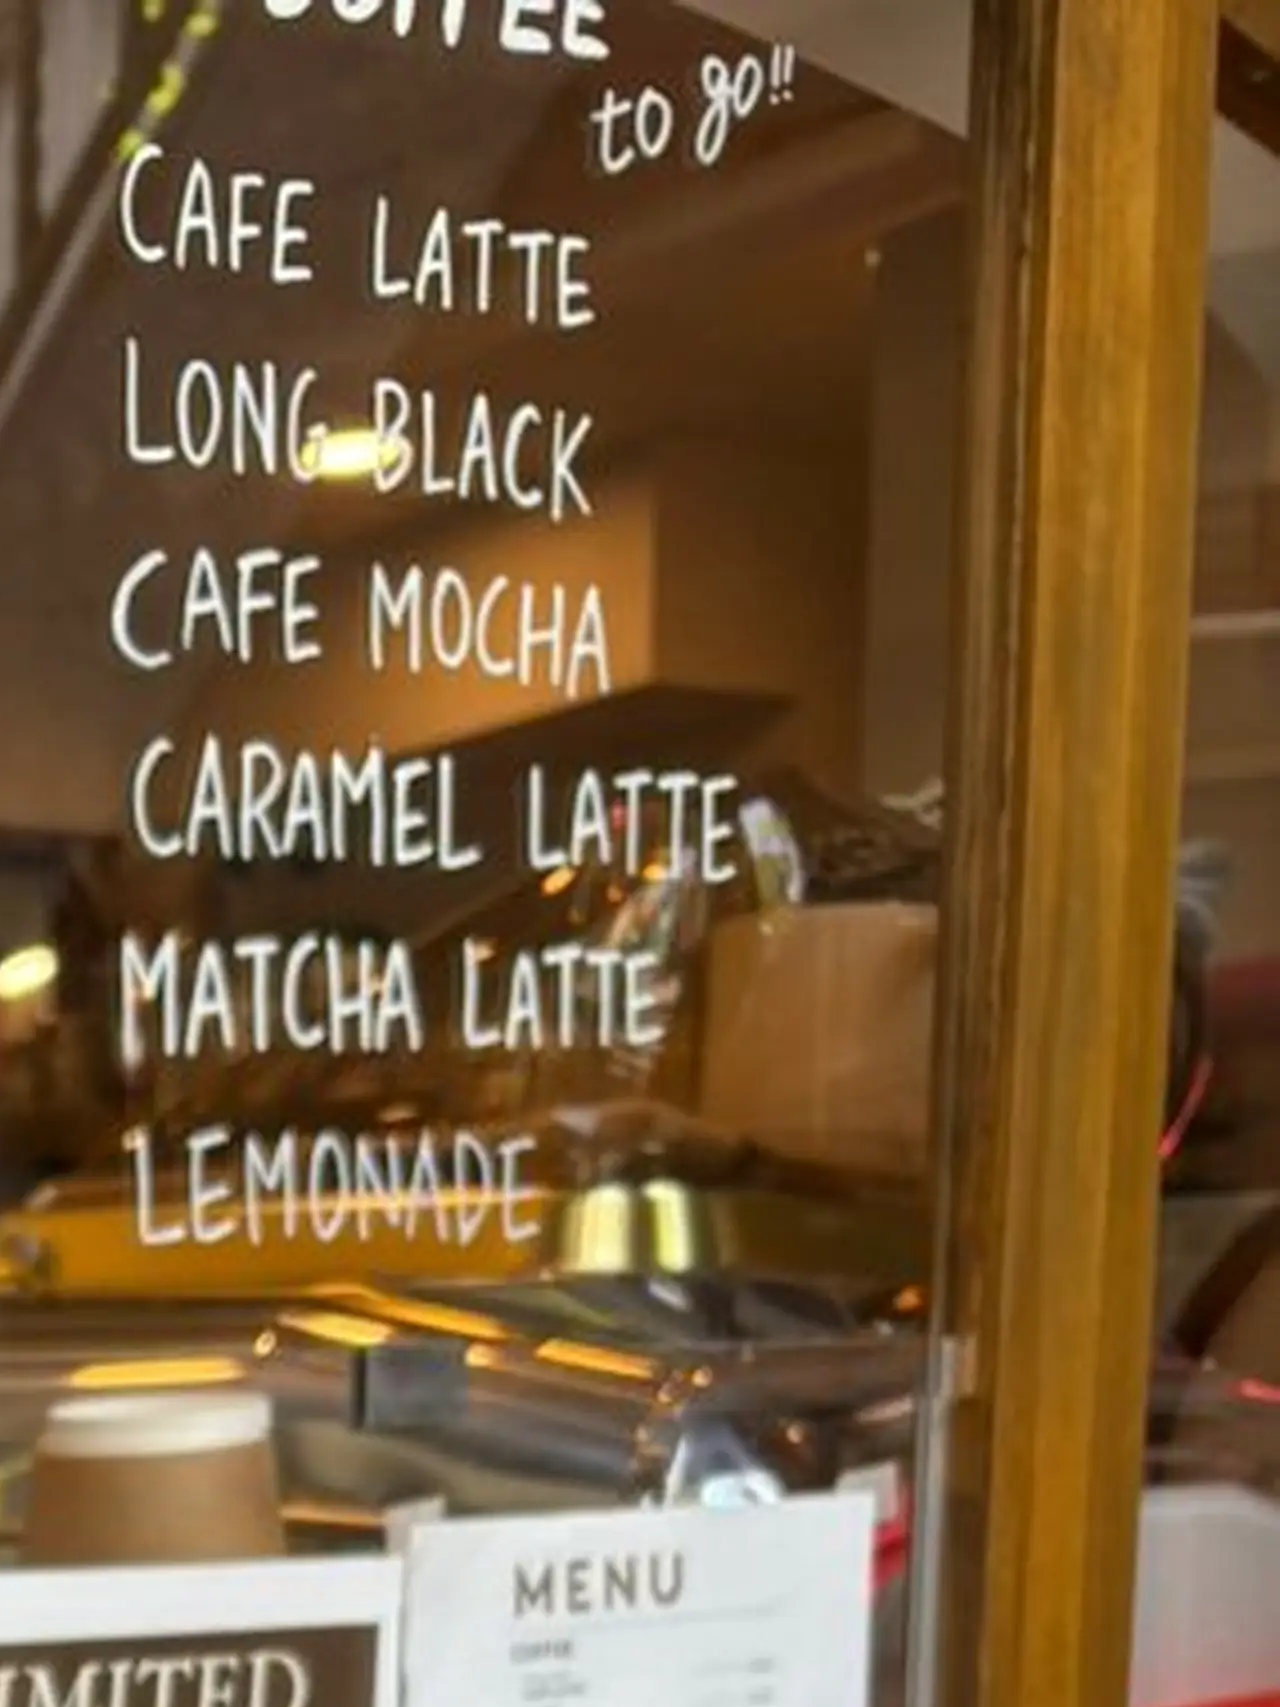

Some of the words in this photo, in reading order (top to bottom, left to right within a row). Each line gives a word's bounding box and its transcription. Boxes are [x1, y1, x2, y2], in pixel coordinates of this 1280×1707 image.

[590, 88, 673, 174] to
[121, 144, 314, 284] CAFE
[372, 197, 595, 328] LATTE
[125, 338, 328, 483] LONG
[372, 378, 593, 521] BLACK
[112, 548, 321, 669] CAFE
[370, 564, 610, 699] MOCHA
[134, 735, 481, 867] CARAMEL
[528, 764, 739, 883] LATTE
[120, 929, 423, 1061] MATCHA
[461, 937, 666, 1048] LATTE
[122, 1124, 542, 1246] LEMONADE
[512, 1552, 685, 1619] MENU
